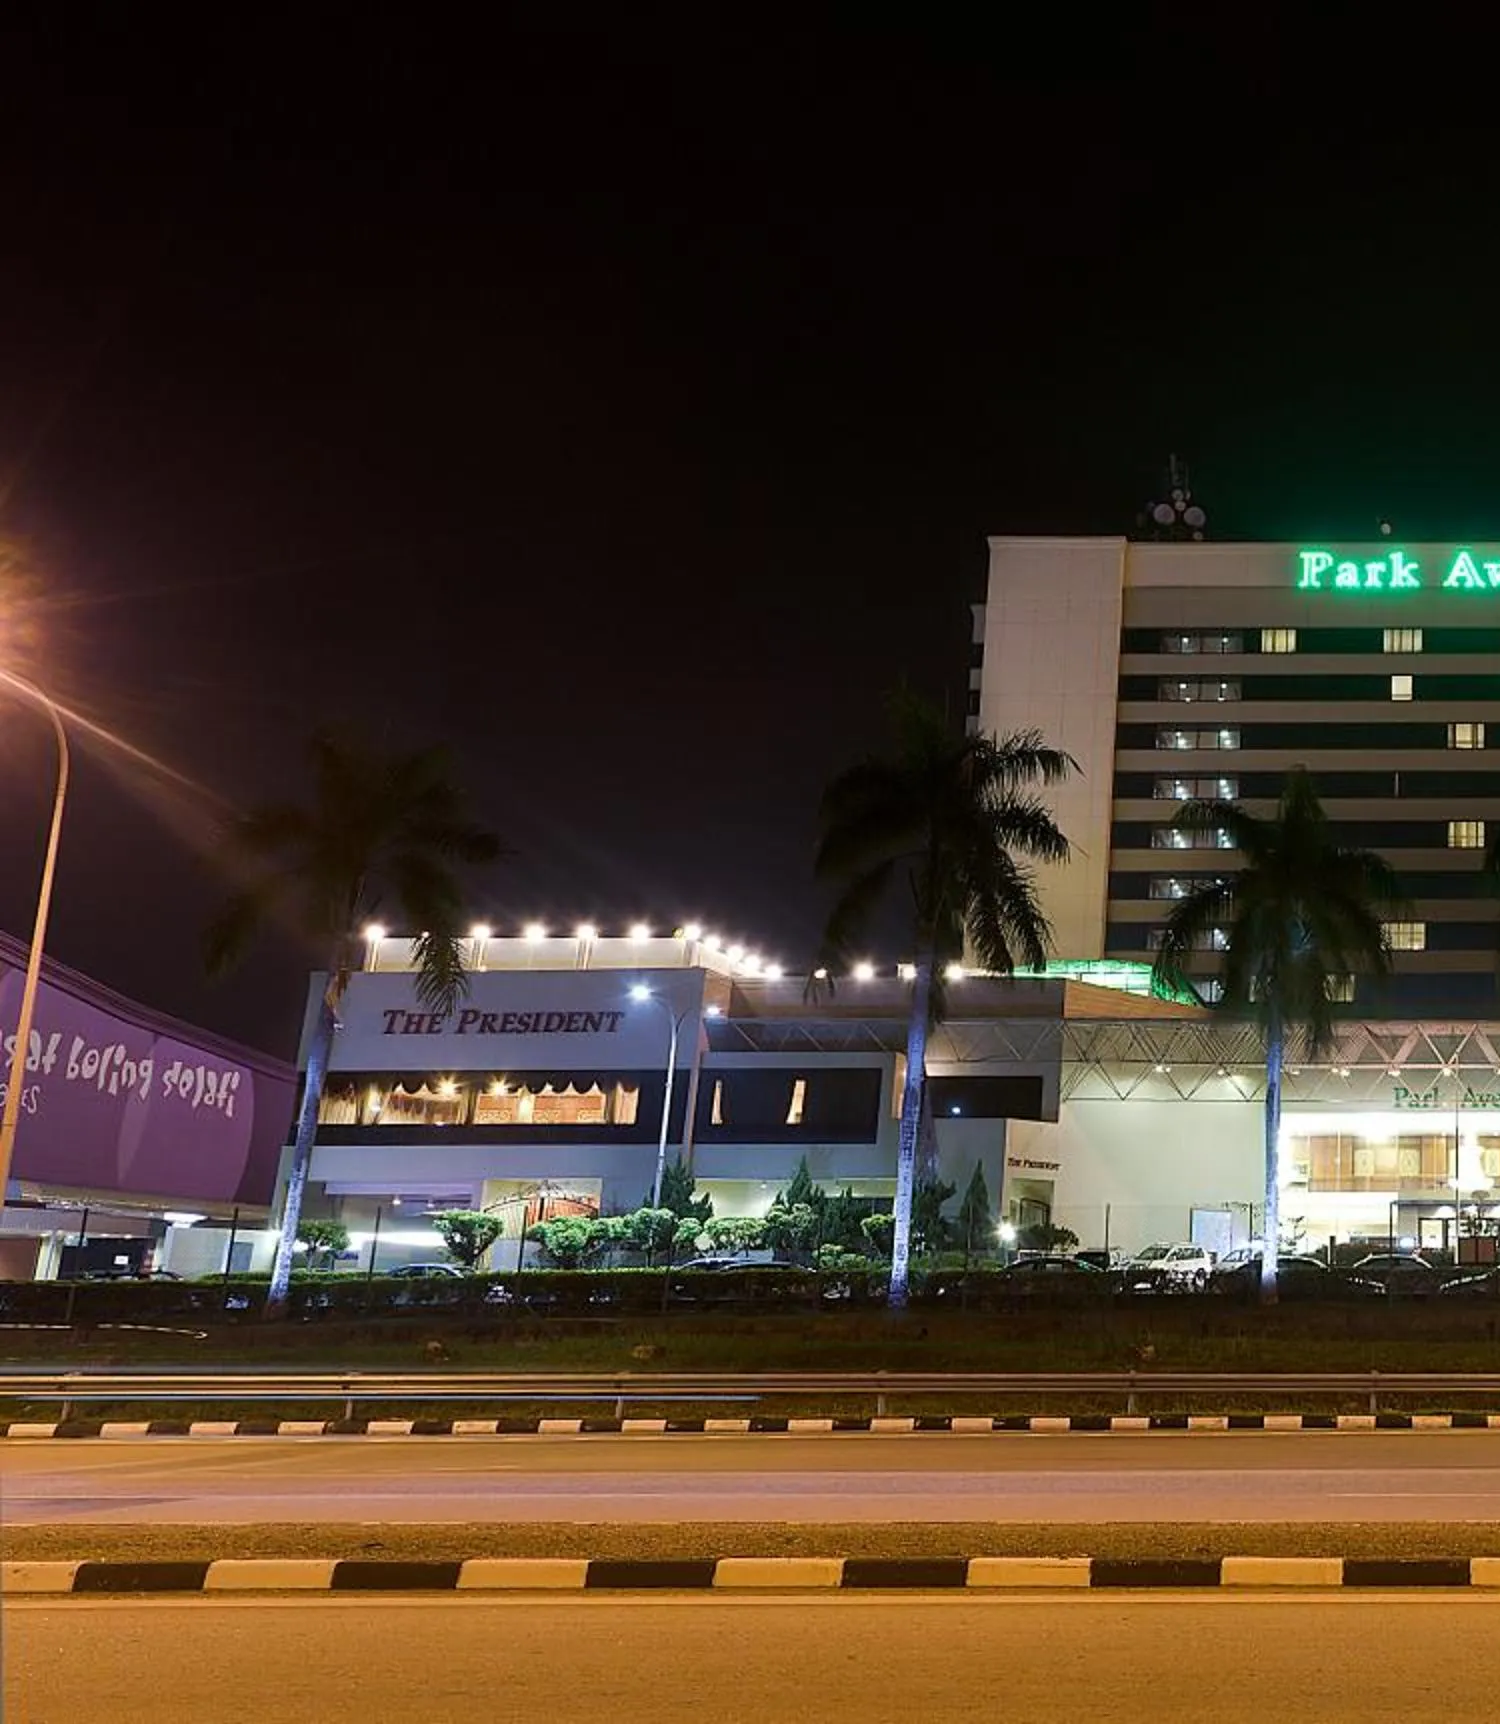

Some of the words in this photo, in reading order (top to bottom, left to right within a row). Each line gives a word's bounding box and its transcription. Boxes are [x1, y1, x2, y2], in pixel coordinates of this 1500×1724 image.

[1297, 549, 1421, 589] Park
[383, 1008, 446, 1035] THE
[454, 1008, 626, 1035] PRESIDENT
[0, 1029, 62, 1076] sat
